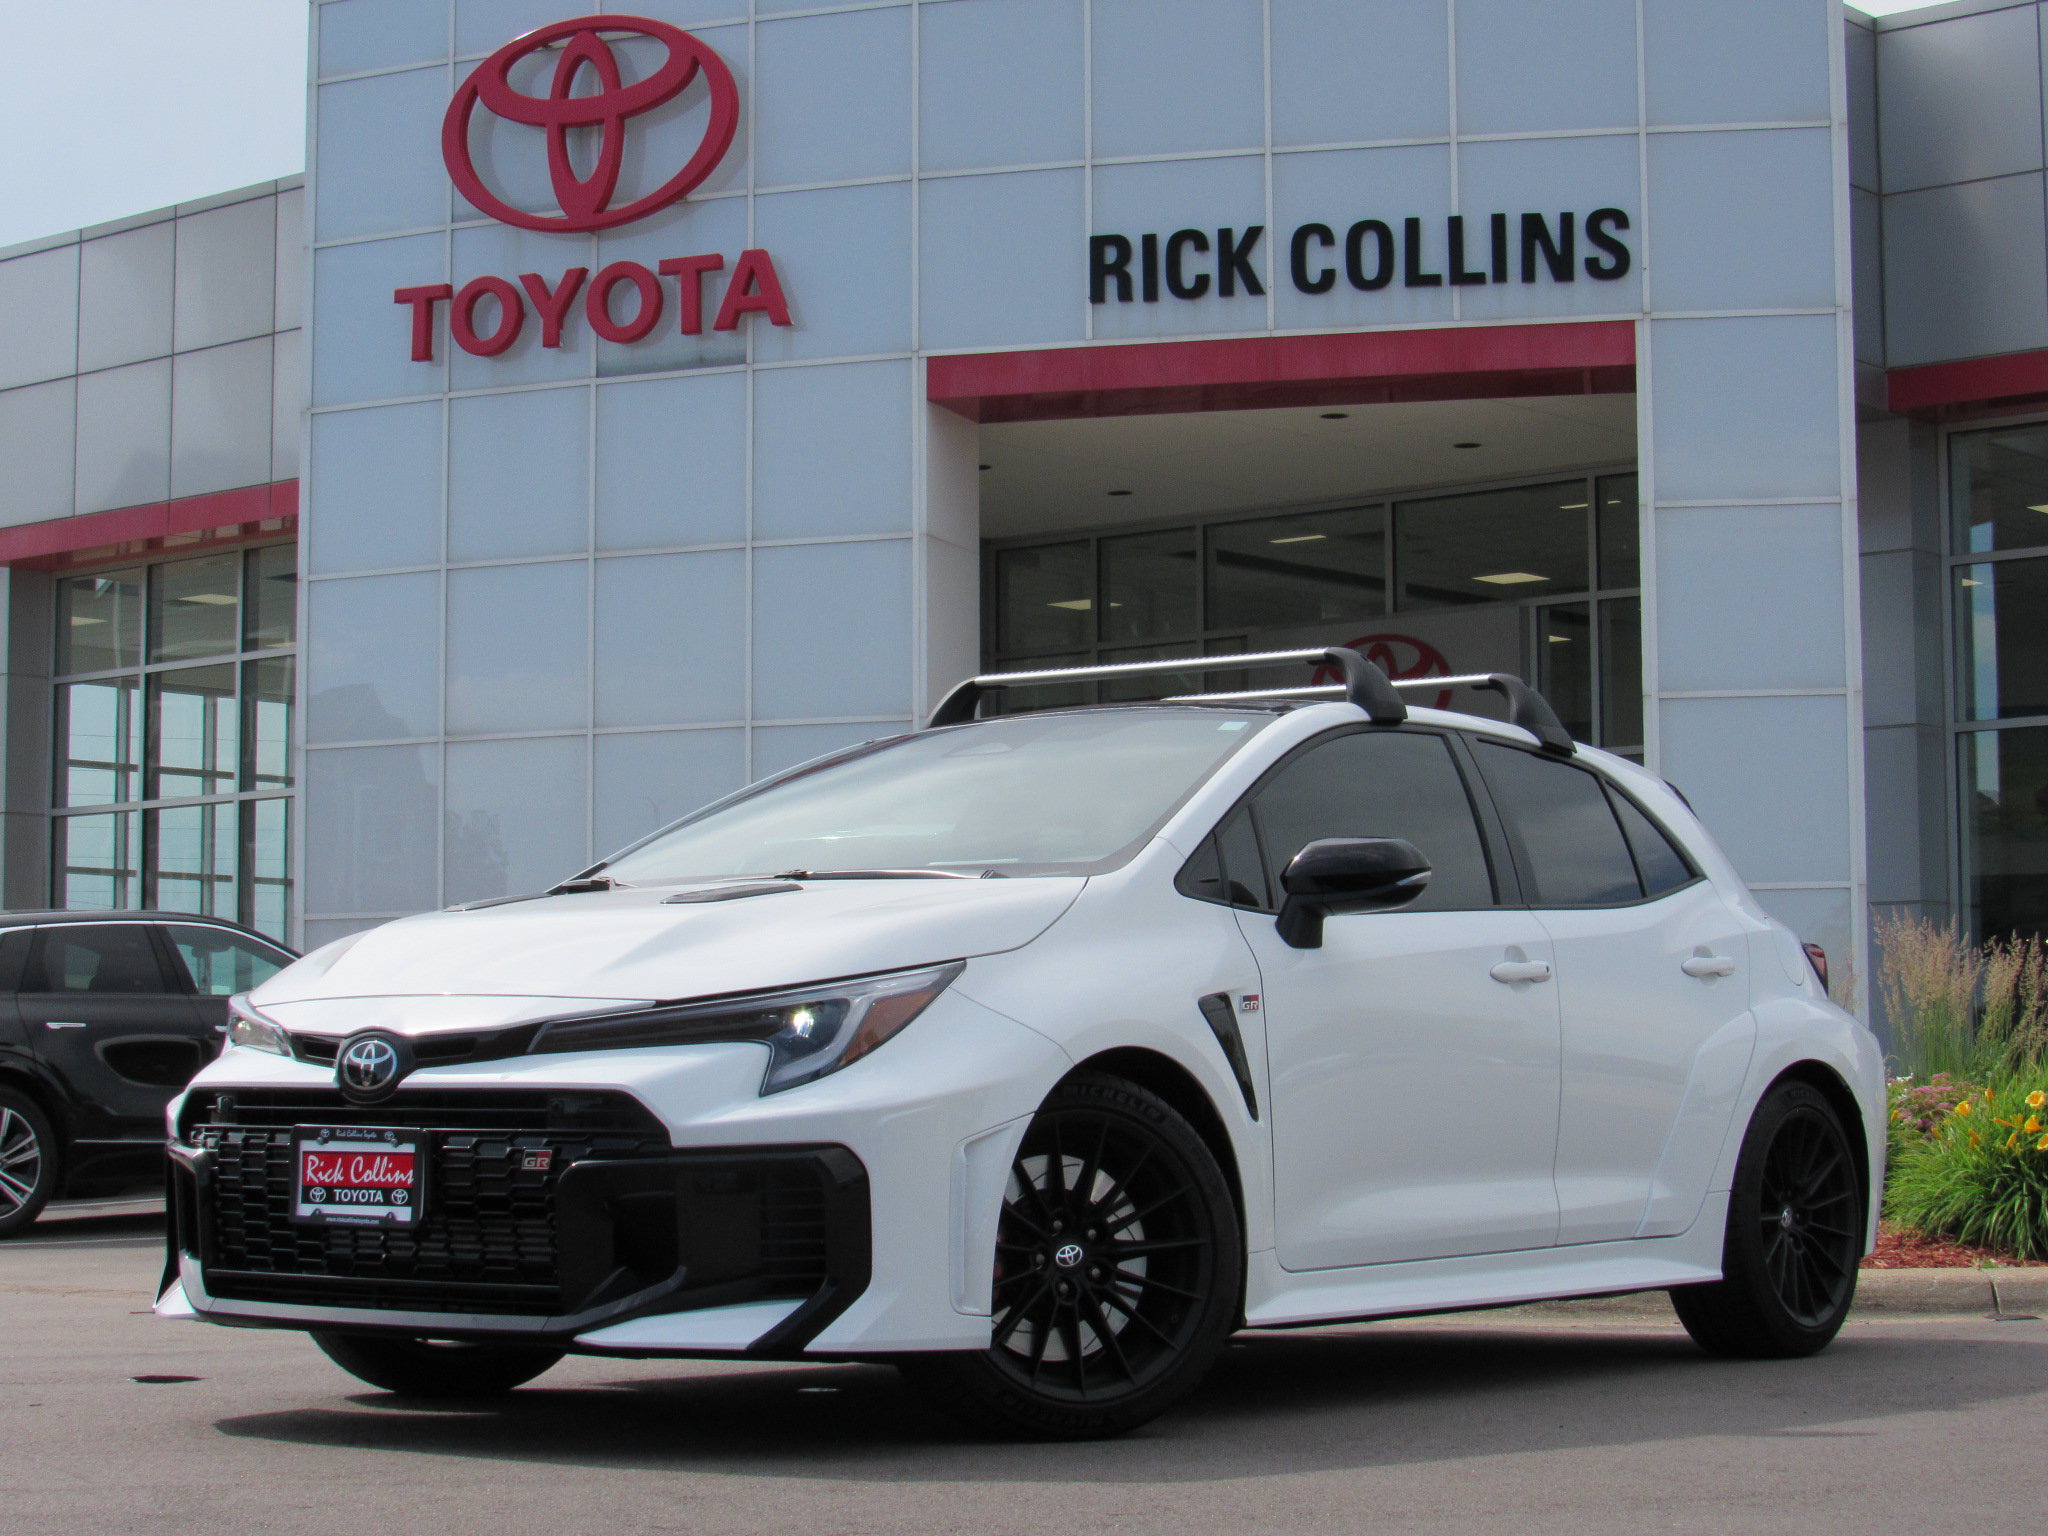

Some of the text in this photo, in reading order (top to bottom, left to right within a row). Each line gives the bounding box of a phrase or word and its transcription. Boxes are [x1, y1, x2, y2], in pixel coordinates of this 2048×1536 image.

[1089, 207, 1631, 304] RICK COLLINS
[394, 248, 794, 362] TOYOTA
[306, 1154, 415, 1185] Rick Collins
[333, 1188, 384, 1203] TOYOTA
